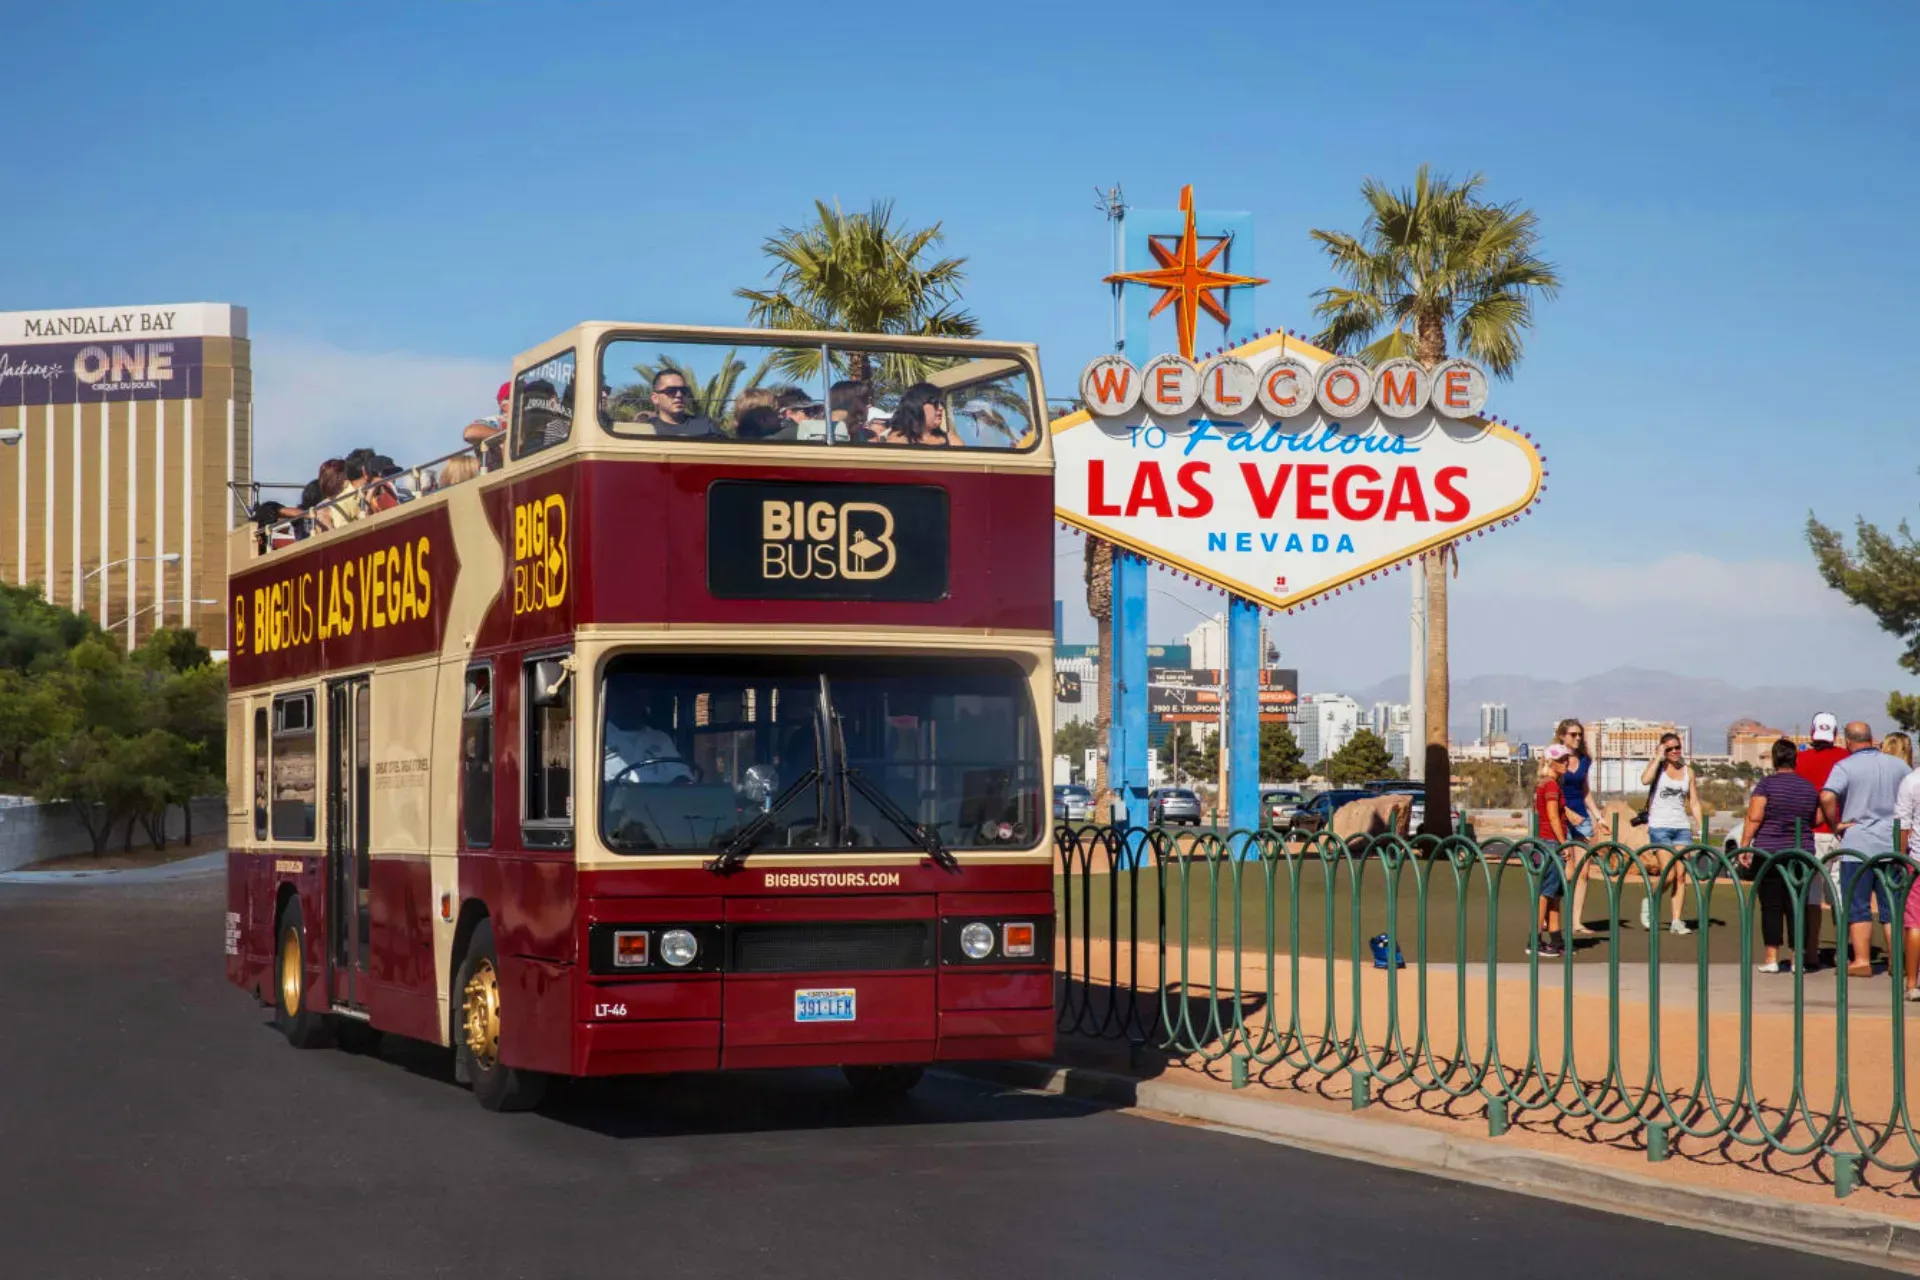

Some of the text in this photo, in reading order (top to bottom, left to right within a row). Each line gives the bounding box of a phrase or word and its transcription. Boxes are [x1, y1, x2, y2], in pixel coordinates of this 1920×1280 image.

[24, 312, 176, 337] MANDALAY BAY
[74, 342, 175, 384] ONE
[1092, 367, 1472, 408] WELCOME
[1126, 418, 1421, 457] TO Fabulous
[1087, 459, 1471, 522] LAS VEGAS
[515, 499, 543, 561] BIG
[763, 500, 837, 541] BIG
[763, 543, 837, 579] BUS
[1207, 532, 1355, 553] NEVADA
[318, 558, 354, 642] LAS
[359, 536, 431, 632] VEGAS
[515, 562, 544, 615] BUS
[1181, 704, 1222, 714] TROPICAN
[764, 873, 900, 887] BIGBUSTOURS.COM
[595, 1003, 627, 1017] LT-46
